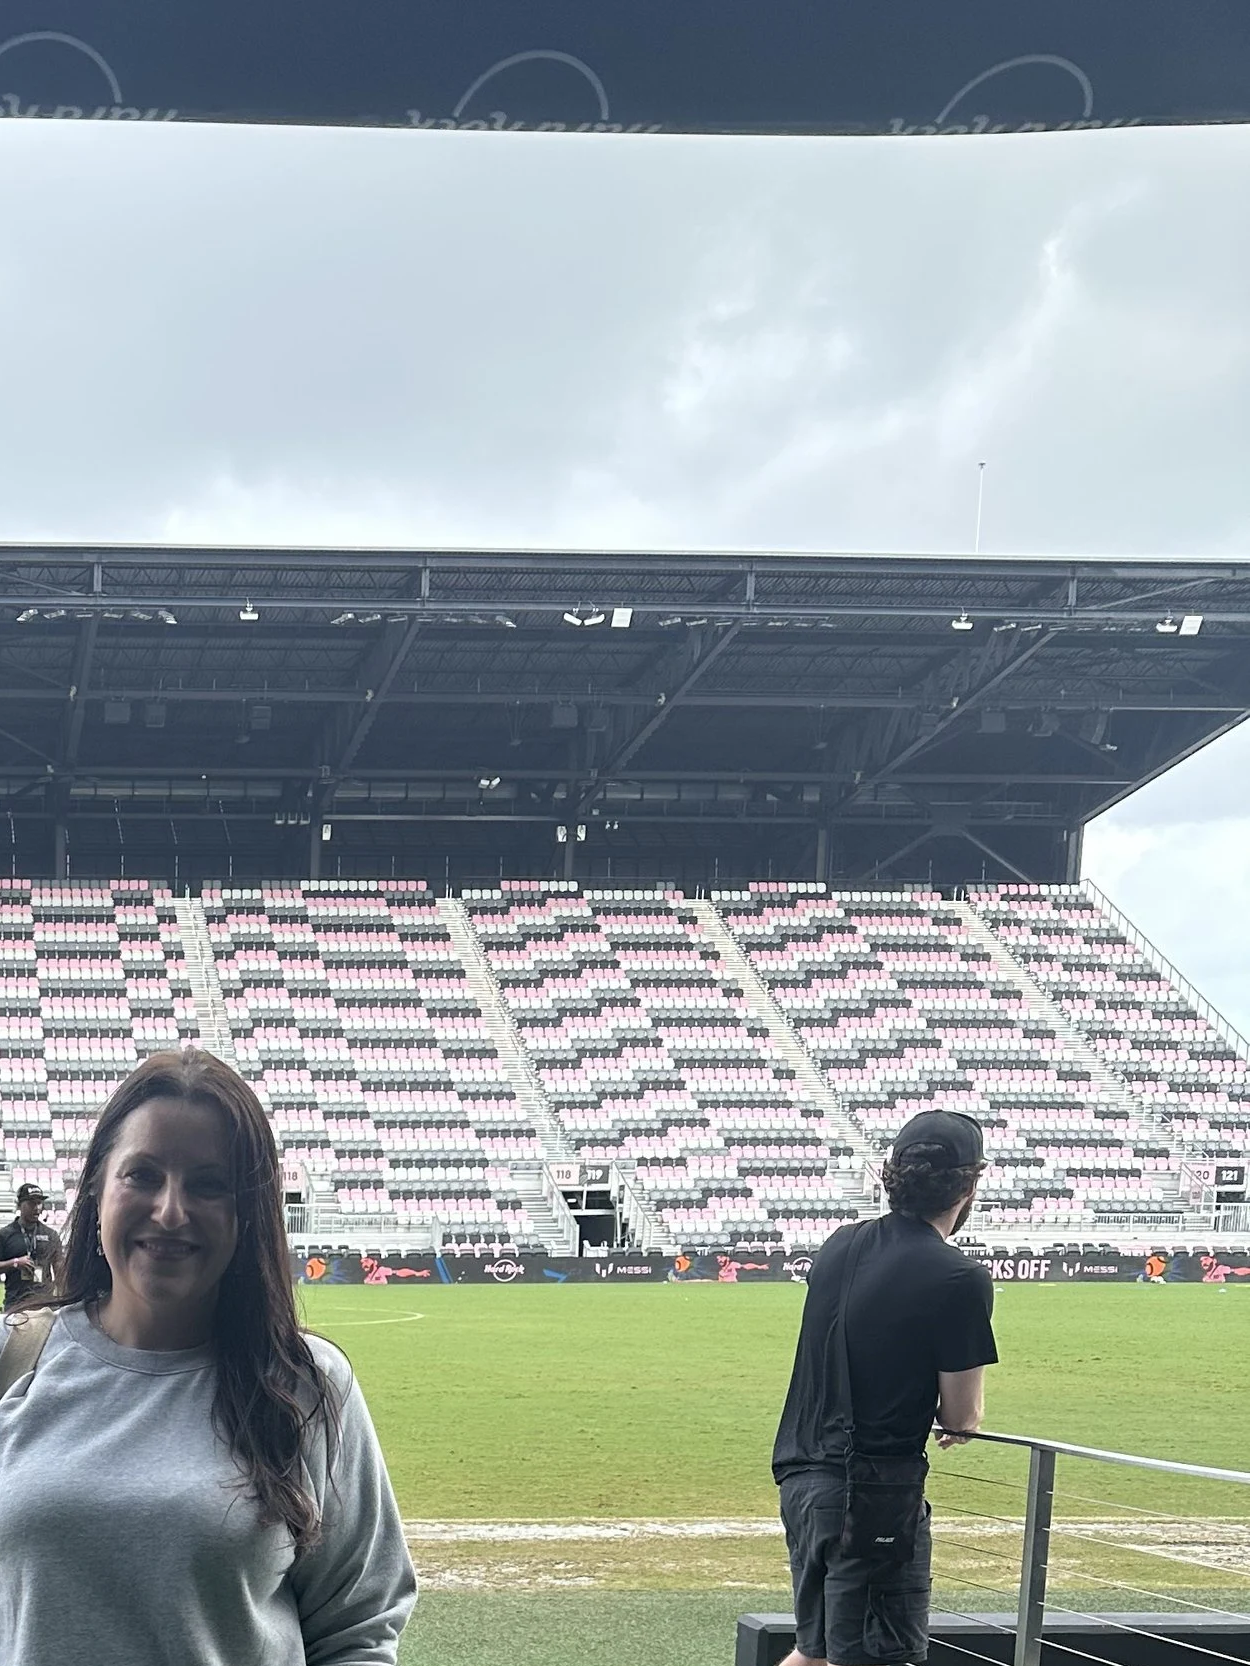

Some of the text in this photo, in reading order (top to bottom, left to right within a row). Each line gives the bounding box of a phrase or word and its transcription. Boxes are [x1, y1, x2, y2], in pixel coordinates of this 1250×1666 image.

[556, 1169, 603, 1180] 118 119
[1221, 1169, 1239, 1181] 121
[483, 1264, 526, 1275] Hard Rock
[616, 1266, 652, 1275] MESSI
[1017, 1259, 1052, 1279] OFF
[1083, 1265, 1119, 1274] MESSI
